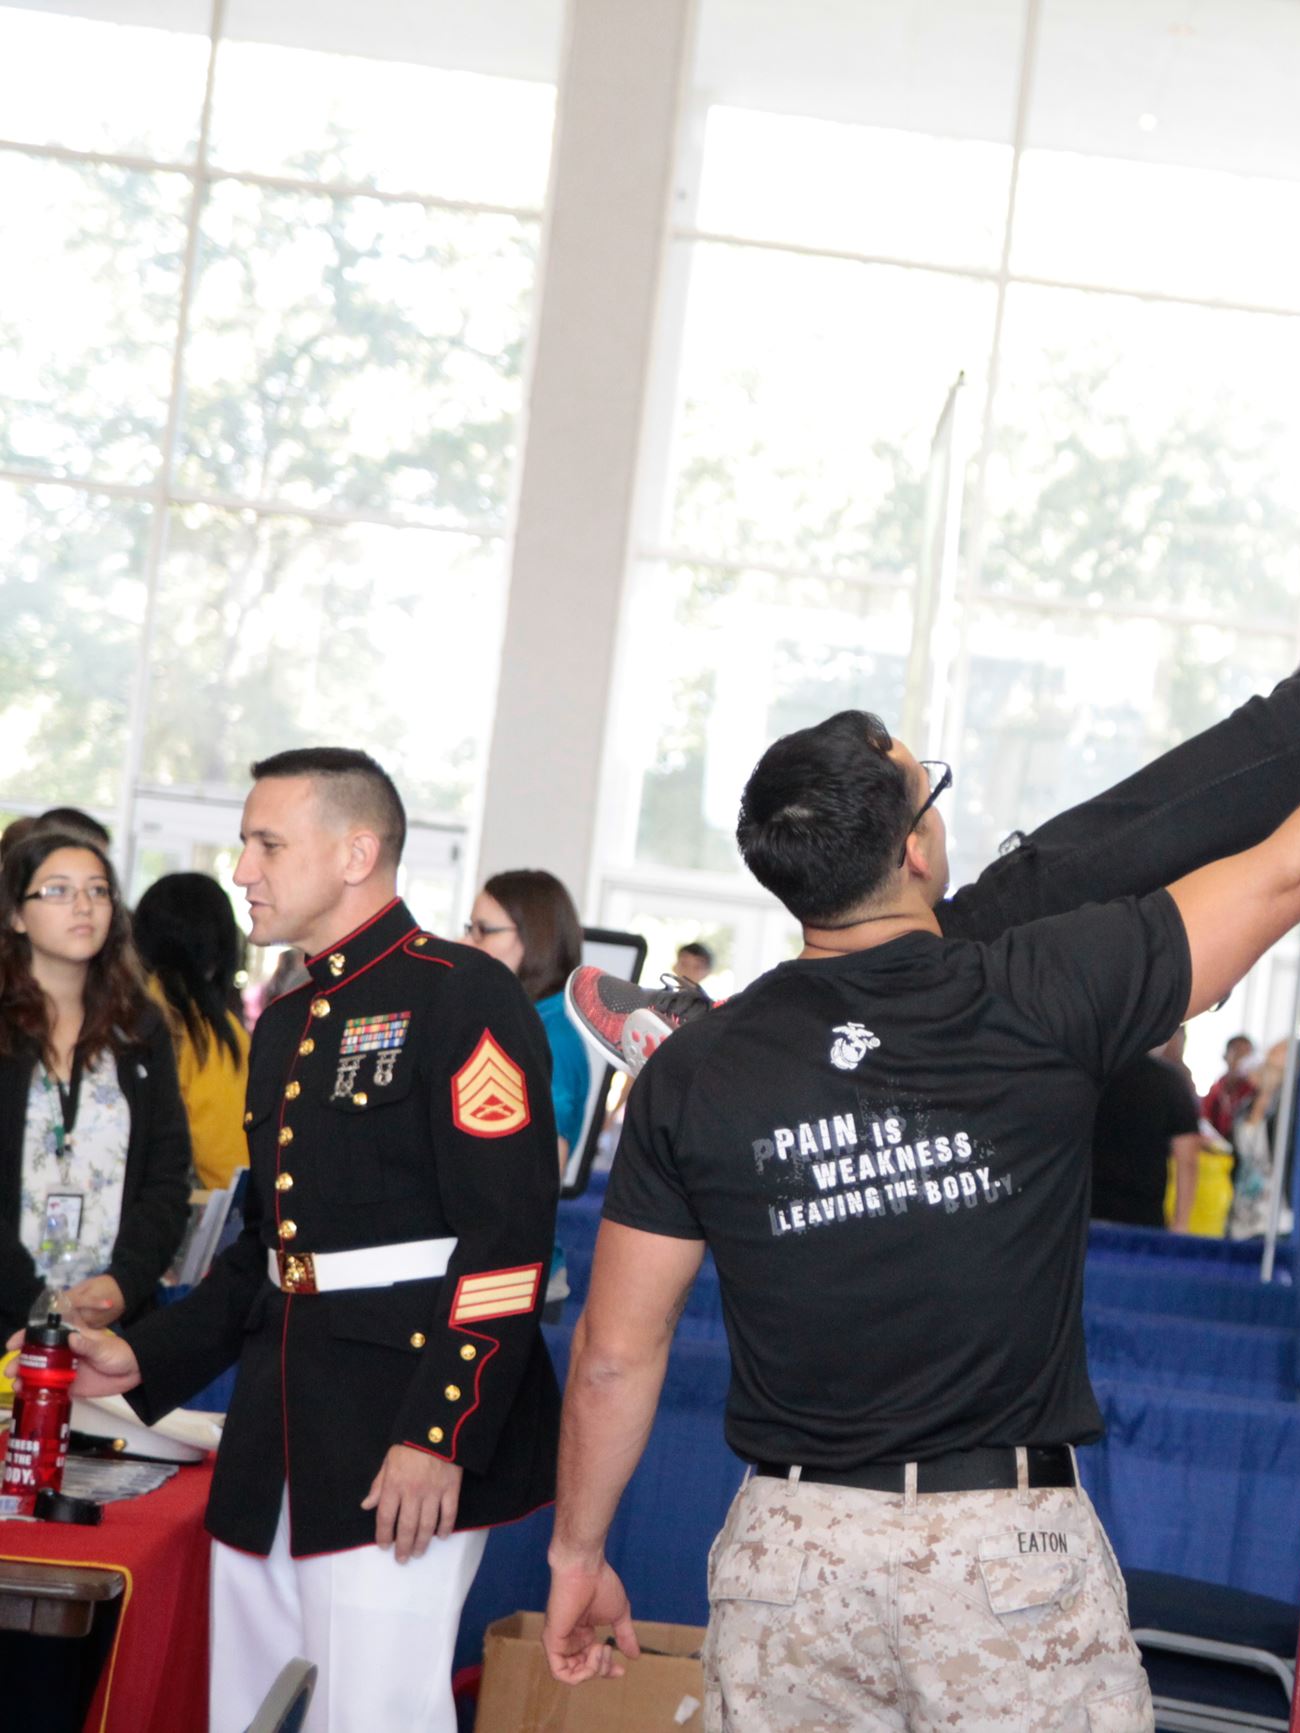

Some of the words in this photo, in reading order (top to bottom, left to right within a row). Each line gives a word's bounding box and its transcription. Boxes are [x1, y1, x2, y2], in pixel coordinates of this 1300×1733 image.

[774, 1113, 858, 1160] PAIN
[872, 1118, 902, 1147] IS
[812, 1131, 973, 1190] WEAKNESS
[777, 1187, 881, 1232] LEAVING
[884, 1179, 918, 1201] THE
[925, 1166, 1001, 1205] BODY.
[1018, 1531, 1068, 1554] EATON
